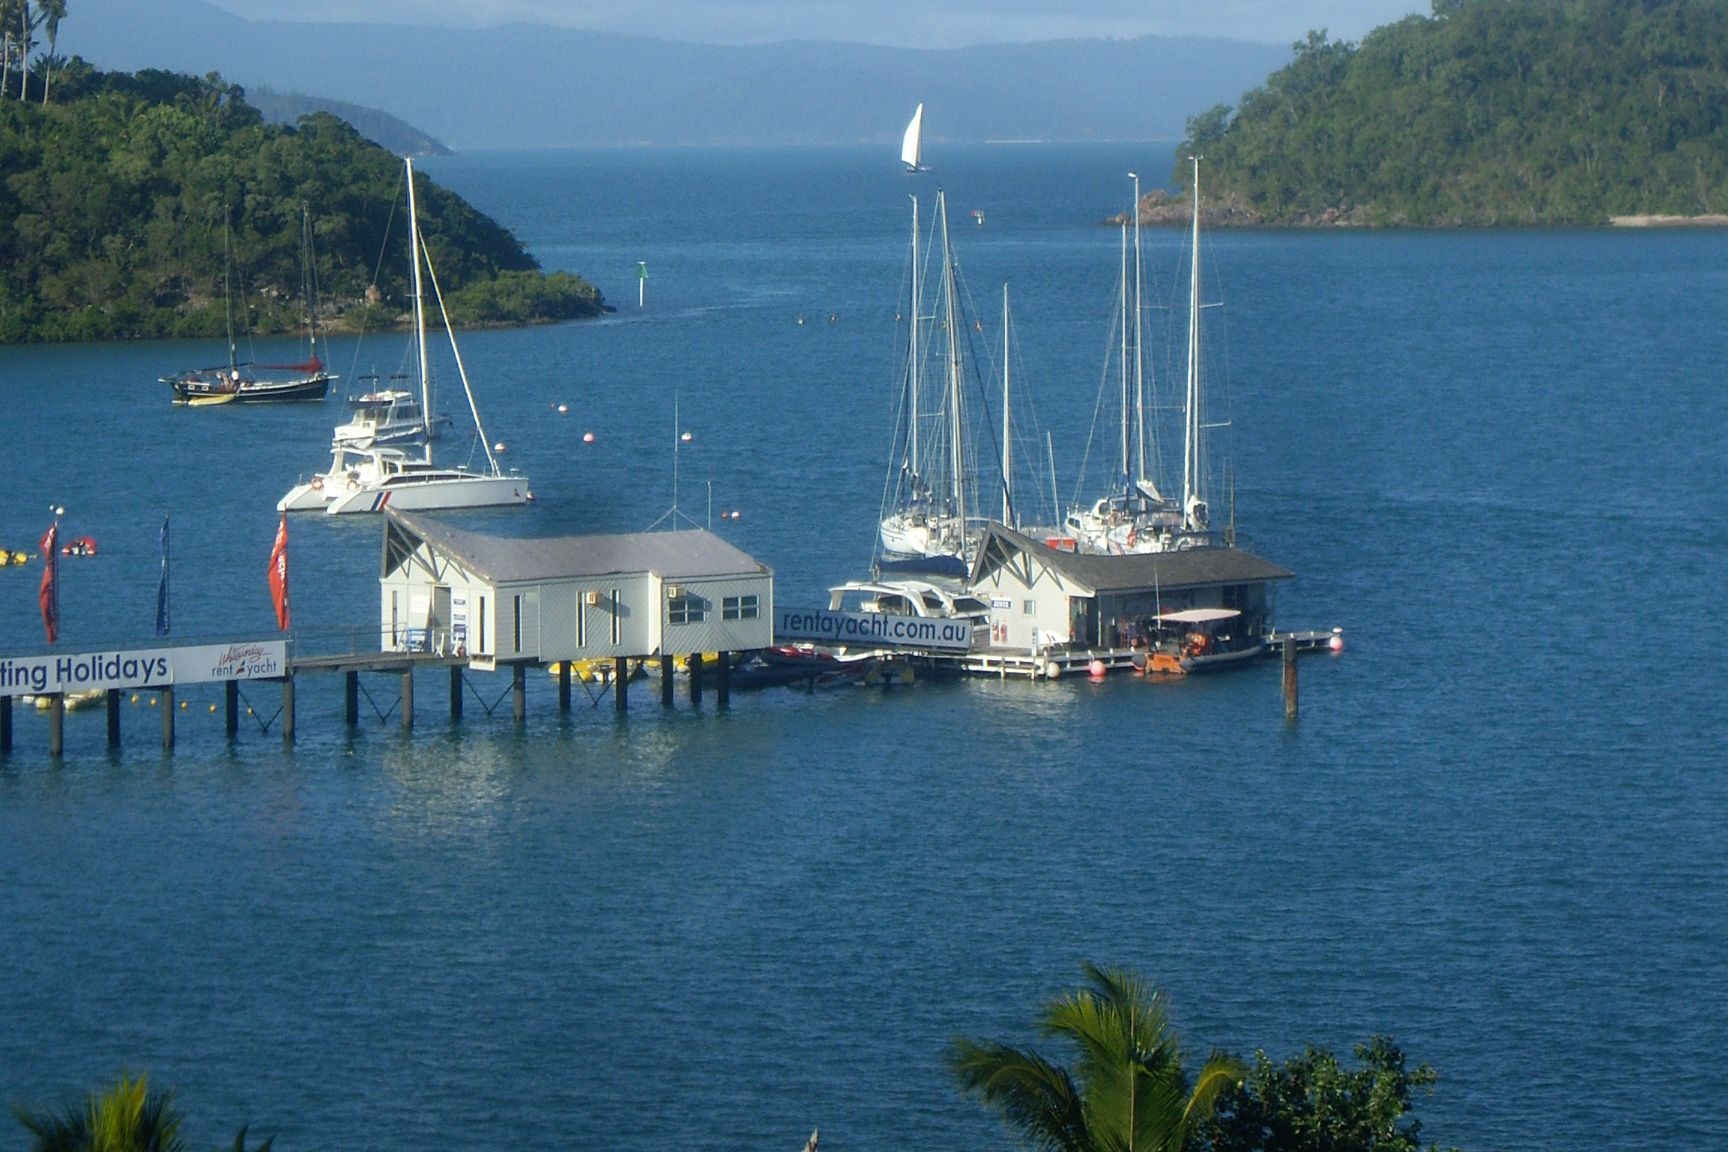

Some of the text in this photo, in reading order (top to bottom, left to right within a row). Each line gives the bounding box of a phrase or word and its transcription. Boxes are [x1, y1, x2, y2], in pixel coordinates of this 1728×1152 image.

[783, 611, 966, 642] rentayacht.com.au
[56, 654, 167, 684] Holidays
[212, 658, 277, 678] rent yacht
